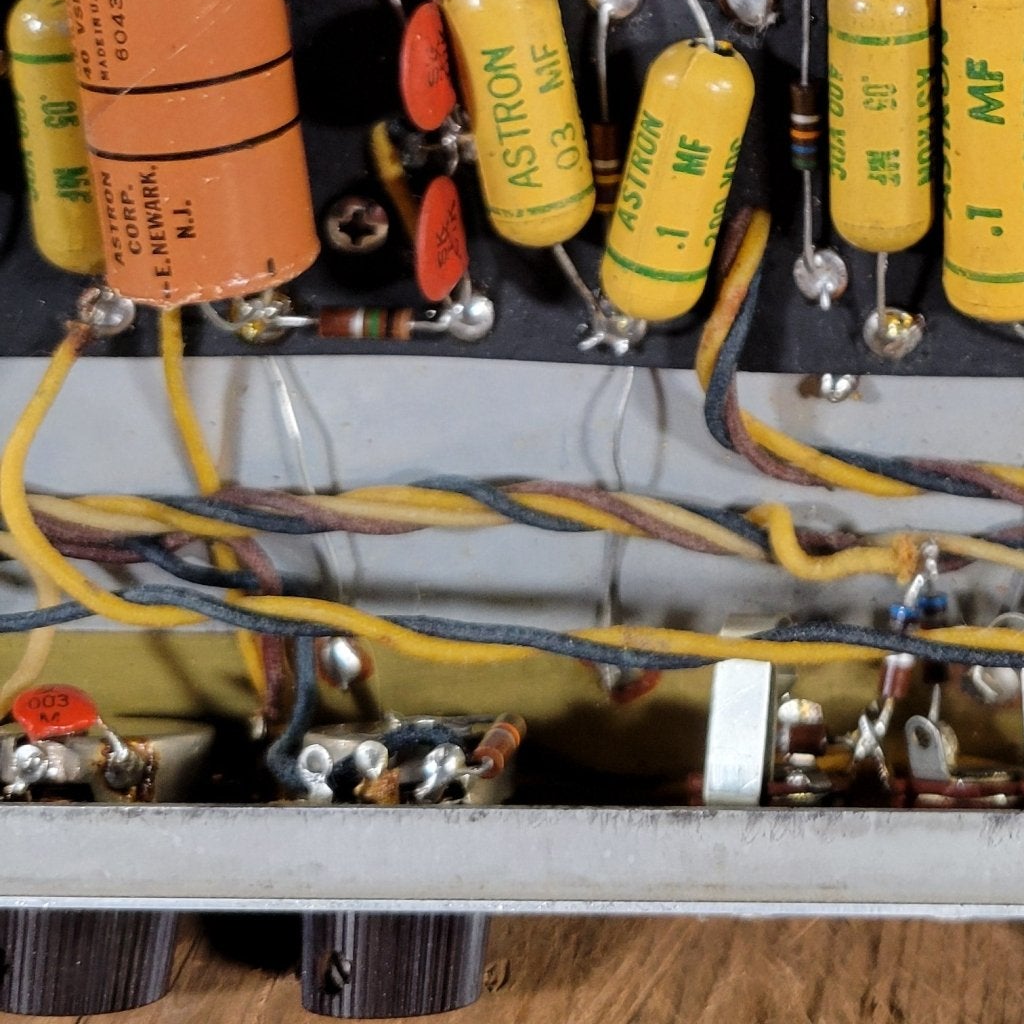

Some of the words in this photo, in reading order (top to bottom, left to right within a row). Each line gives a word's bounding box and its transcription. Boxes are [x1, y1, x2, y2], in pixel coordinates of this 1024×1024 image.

[95, 39, 110, 81] MADE
[530, 43, 565, 95] MF
[965, 56, 1006, 126] MF
[481, 44, 543, 189] ASTRON
[617, 109, 665, 232] ASTRON
[672, 133, 712, 177] MF
[101, 171, 125, 267] ASTRON
[121, 184, 143, 255] CORP.
[172, 199, 197, 239] N.J.
[655, 225, 690, 251] .1
[965, 204, 1005, 238] .1
[27, 692, 70, 710] 003
